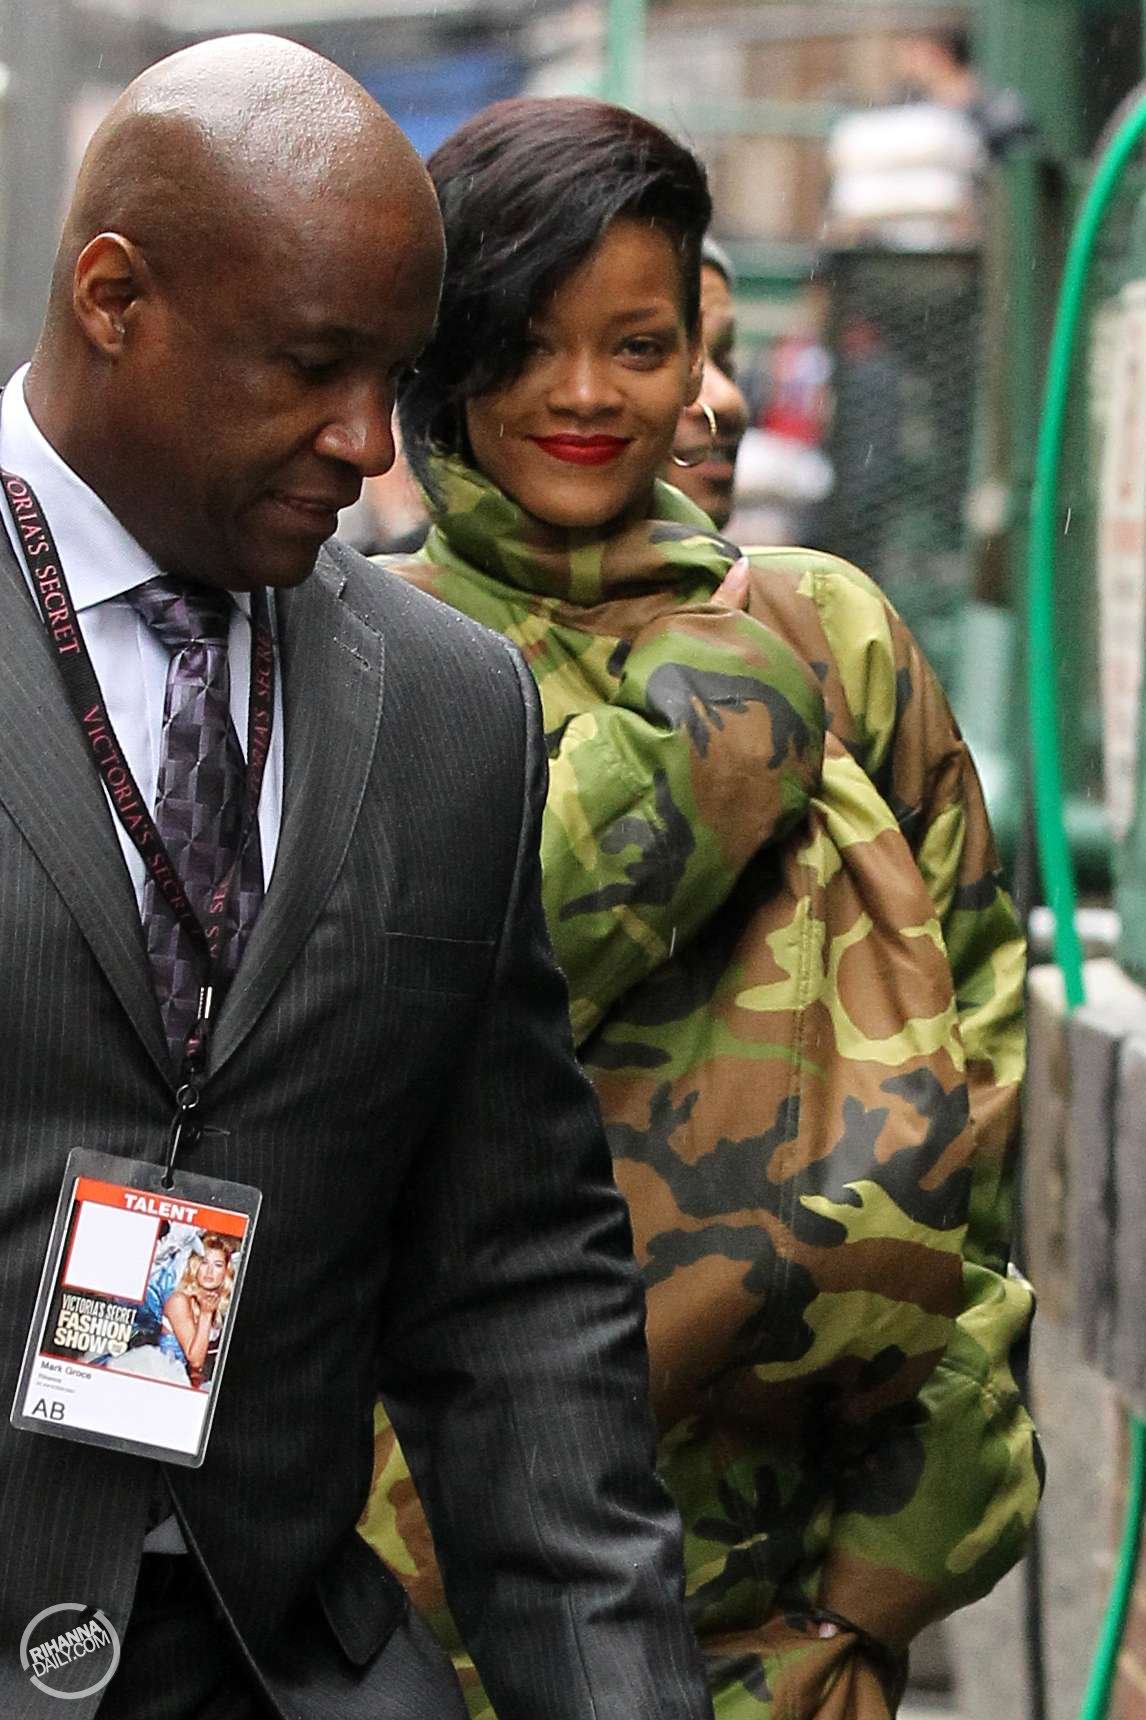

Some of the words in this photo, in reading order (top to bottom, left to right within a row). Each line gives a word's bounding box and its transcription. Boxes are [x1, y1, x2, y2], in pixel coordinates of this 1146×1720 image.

[3, 475, 49, 556] ORIA'S
[35, 565, 81, 655] SECRET
[83, 704, 152, 846] VICTORIA'S
[124, 1193, 198, 1223] TALENT
[57, 1309, 132, 1343] FASHION
[105, 1303, 137, 1325] SECRET
[53, 1327, 108, 1354] SHOW
[40, 1360, 63, 1374] Mark
[32, 1398, 66, 1421] AB
